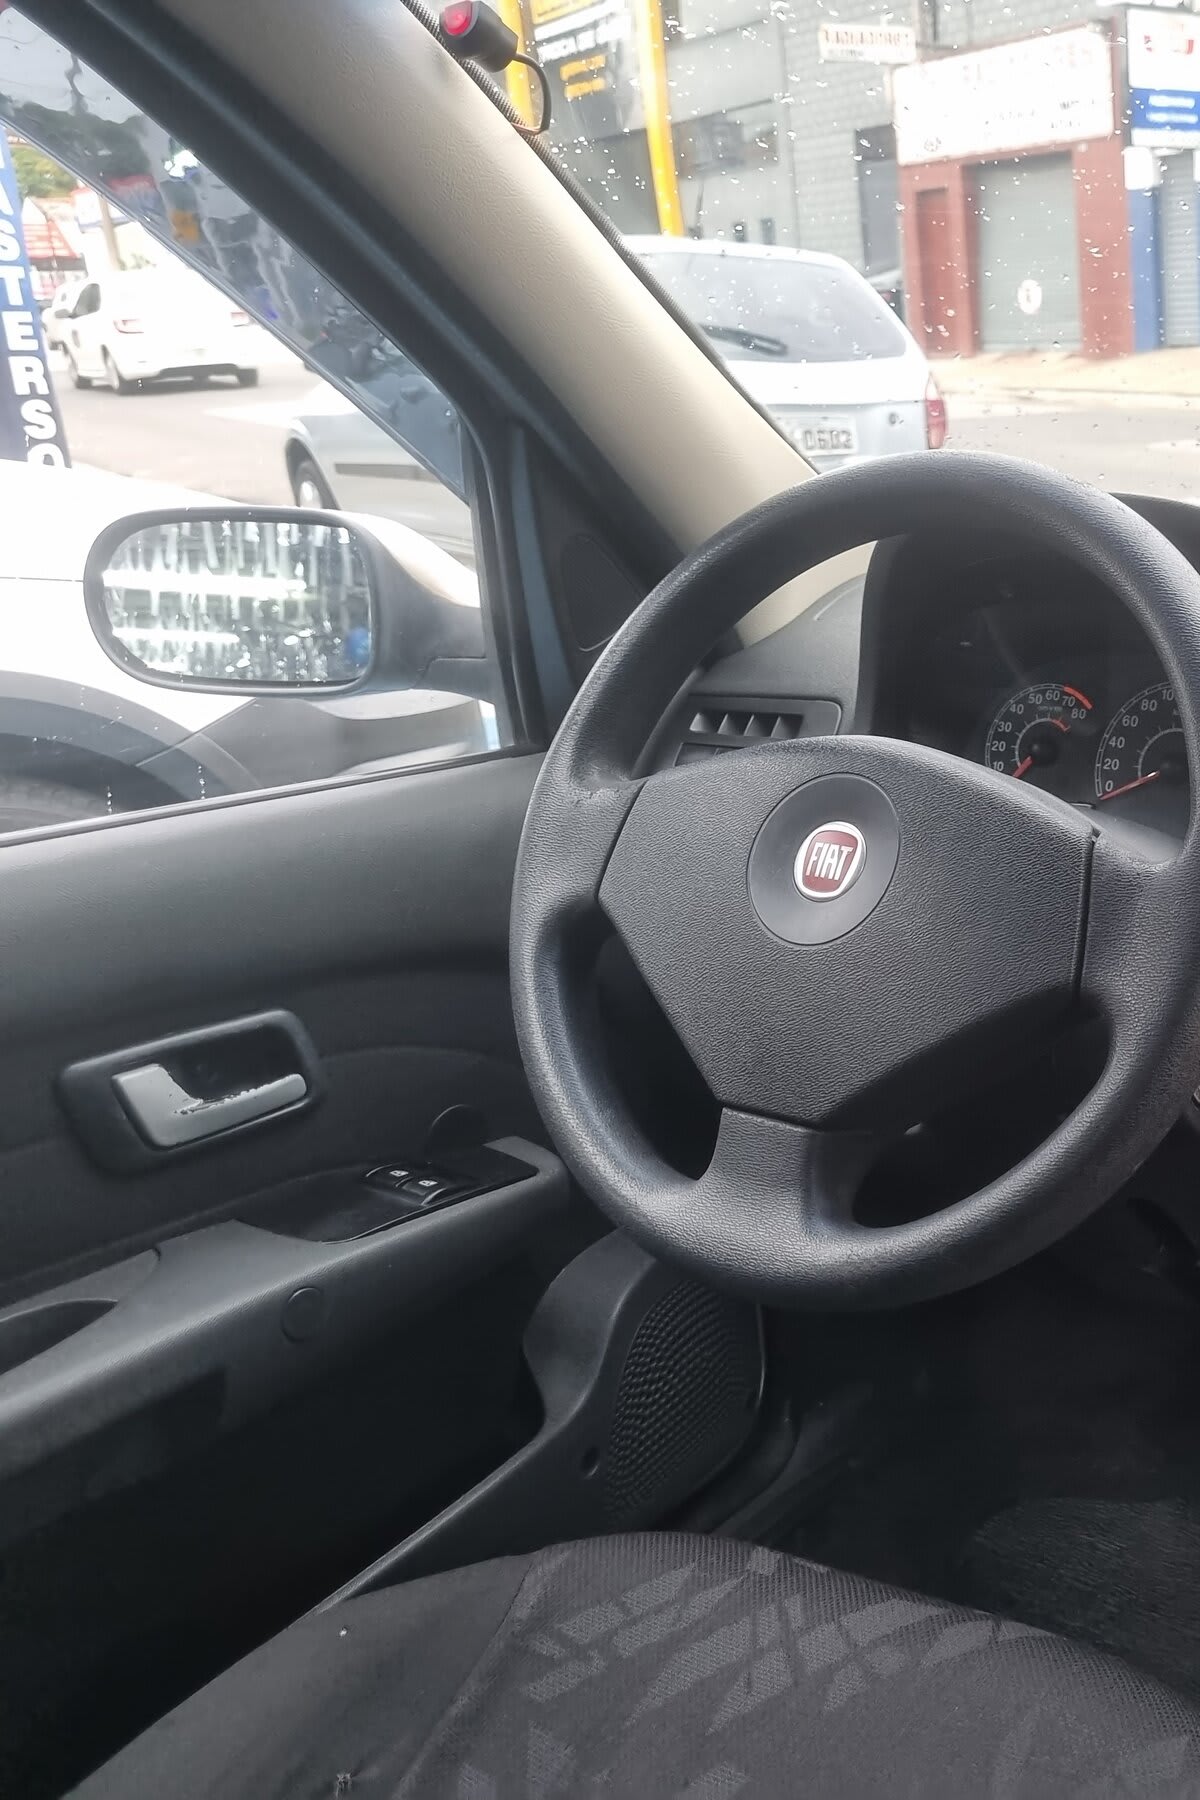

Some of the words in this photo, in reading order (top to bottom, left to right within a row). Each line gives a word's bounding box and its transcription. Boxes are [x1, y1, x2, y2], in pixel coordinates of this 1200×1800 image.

[0, 126, 65, 468] STERSO
[1028, 693, 1043, 704] 50
[1045, 690, 1060, 700] 60
[1161, 689, 1175, 700] 10
[1062, 696, 1076, 707] 70
[1141, 699, 1158, 711] 80
[1009, 704, 1025, 714] 40
[1071, 708, 1087, 719] 80
[1122, 715, 1139, 727] 60
[997, 722, 1012, 732] 30
[991, 741, 1006, 752] 20
[1108, 736, 1126, 748] 40
[993, 761, 1004, 771] 10
[1103, 758, 1120, 770] 20
[1105, 780, 1114, 792] 0
[805, 842, 854, 880] FIAT
